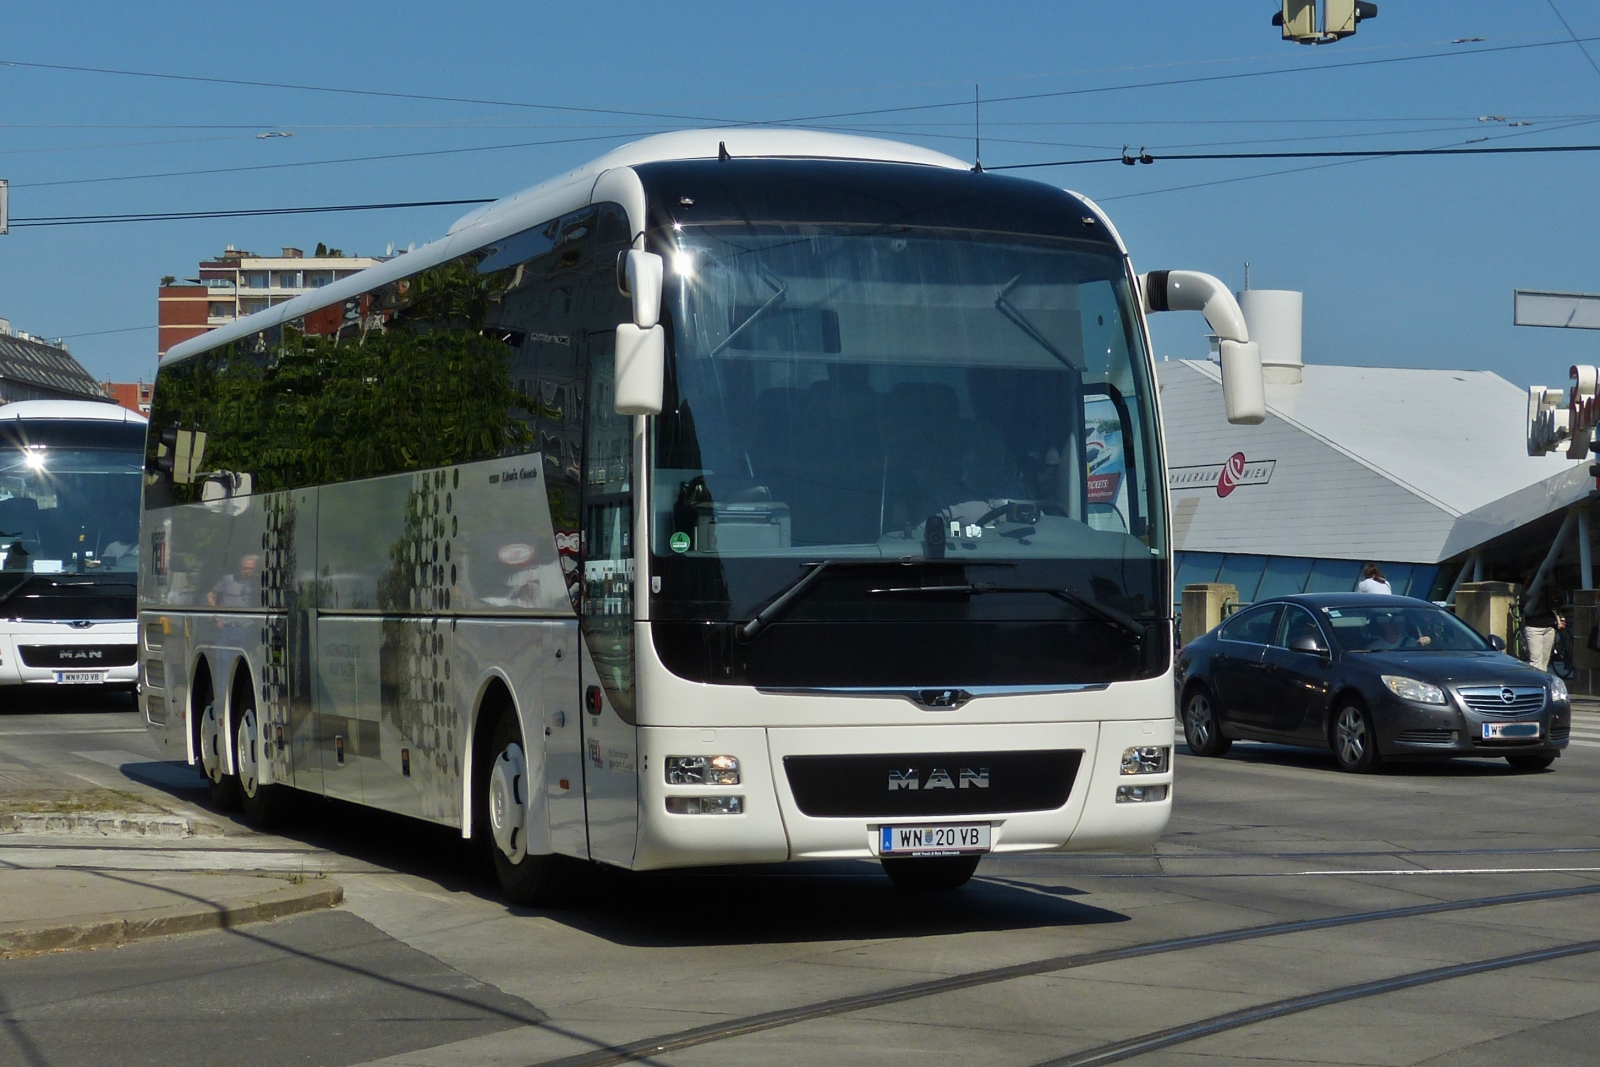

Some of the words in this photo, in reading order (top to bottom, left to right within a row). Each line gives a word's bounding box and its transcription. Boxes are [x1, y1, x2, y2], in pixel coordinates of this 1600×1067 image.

[1169, 472, 1218, 484] ONAURAUM
[1243, 468, 1267, 479] WIEN
[677, 533, 683, 543] 4
[59, 650, 102, 659] MAN
[1491, 725, 1498, 736] W
[888, 767, 990, 791] MAN
[900, 829, 923, 847] WN
[935, 829, 955, 846] 20
[960, 828, 980, 846] VB
